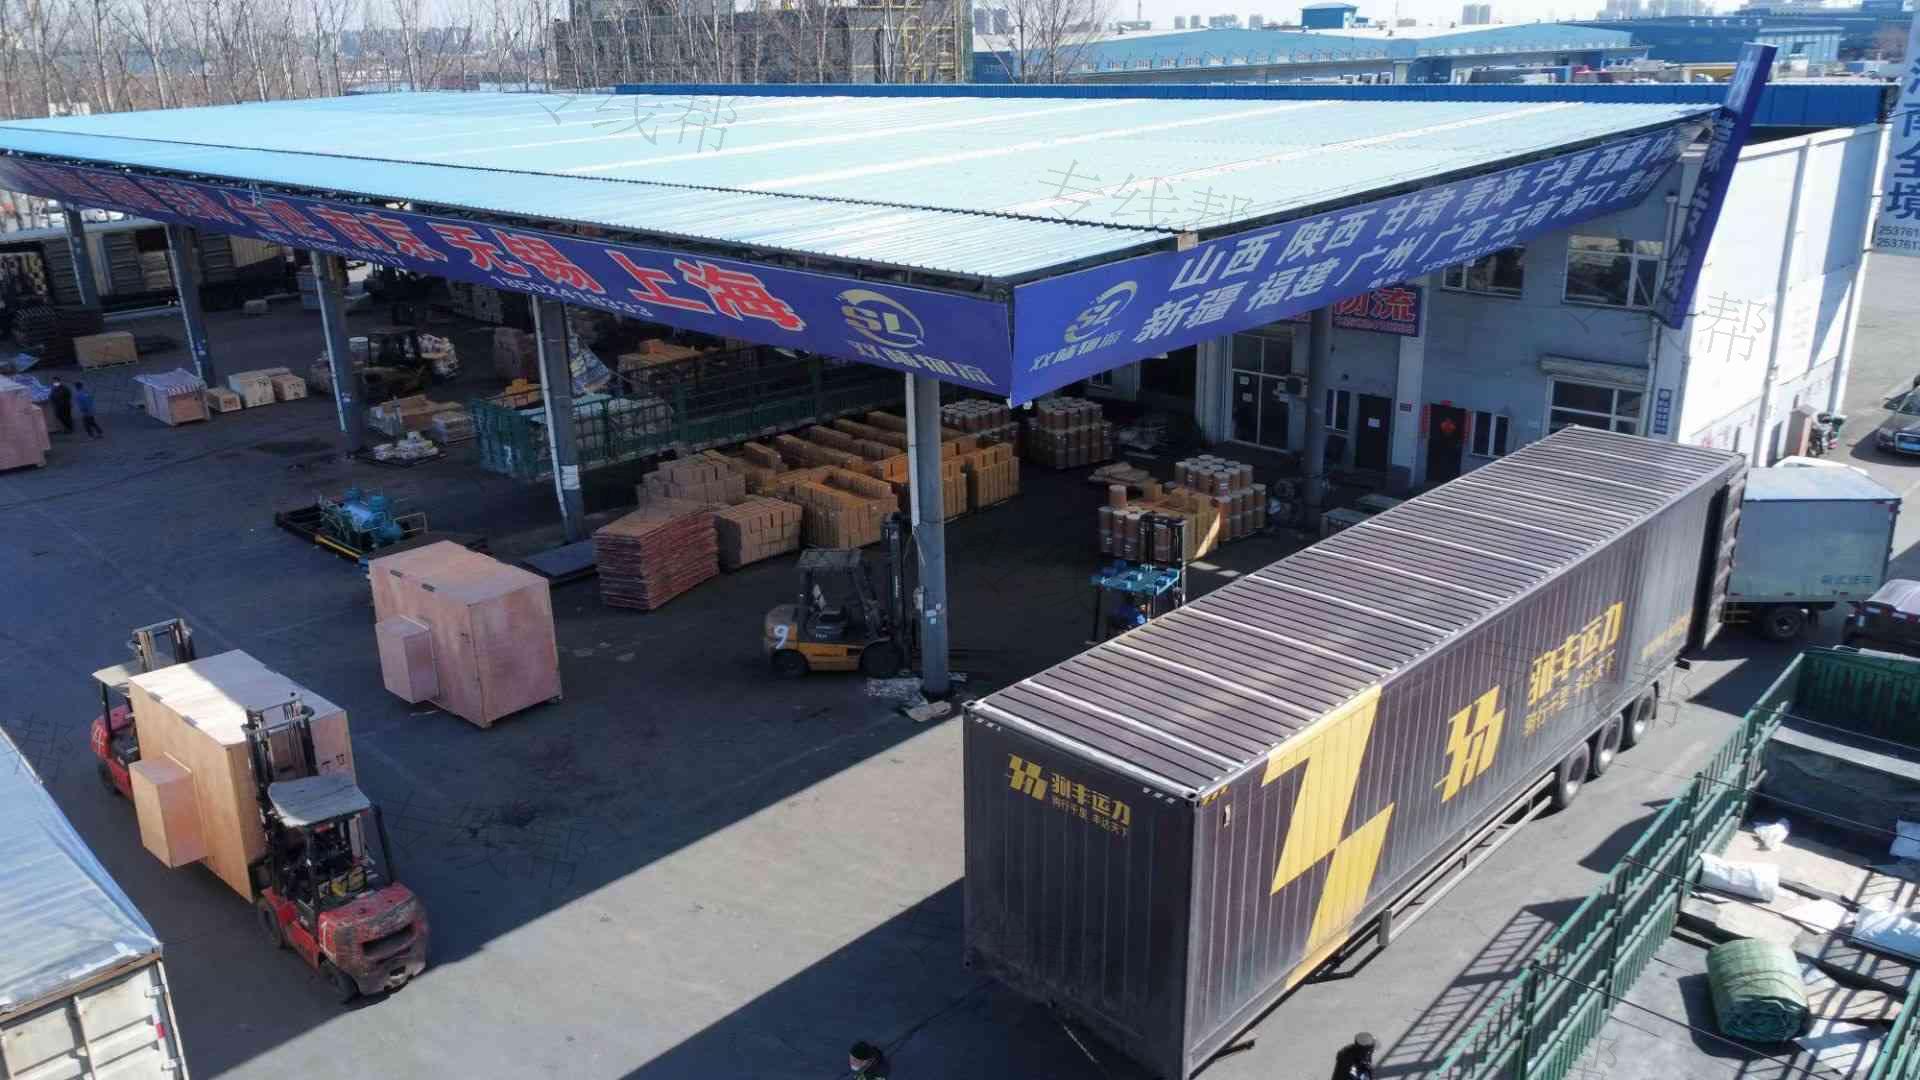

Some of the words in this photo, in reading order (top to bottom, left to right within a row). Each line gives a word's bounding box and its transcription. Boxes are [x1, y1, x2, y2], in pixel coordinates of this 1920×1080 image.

[306, 203, 449, 263] 南京
[425, 221, 606, 295] 无锡
[604, 248, 807, 332] 上海
[1133, 281, 1249, 343] 新疆
[1244, 257, 1342, 313] 福建
[1335, 233, 1426, 287] 广州
[1416, 214, 1500, 262] 广西
[1490, 195, 1561, 239] 云南
[1551, 181, 1617, 219] 海口
[1169, 231, 1281, 292] 山西
[1275, 207, 1378, 266] 陕西
[1376, 188, 1456, 239] 甘肃
[1454, 169, 1532, 219] 青海
[1528, 154, 1592, 197] 宁夏
[1584, 137, 1652, 179] 西藏
[773, 624, 790, 650] 9
